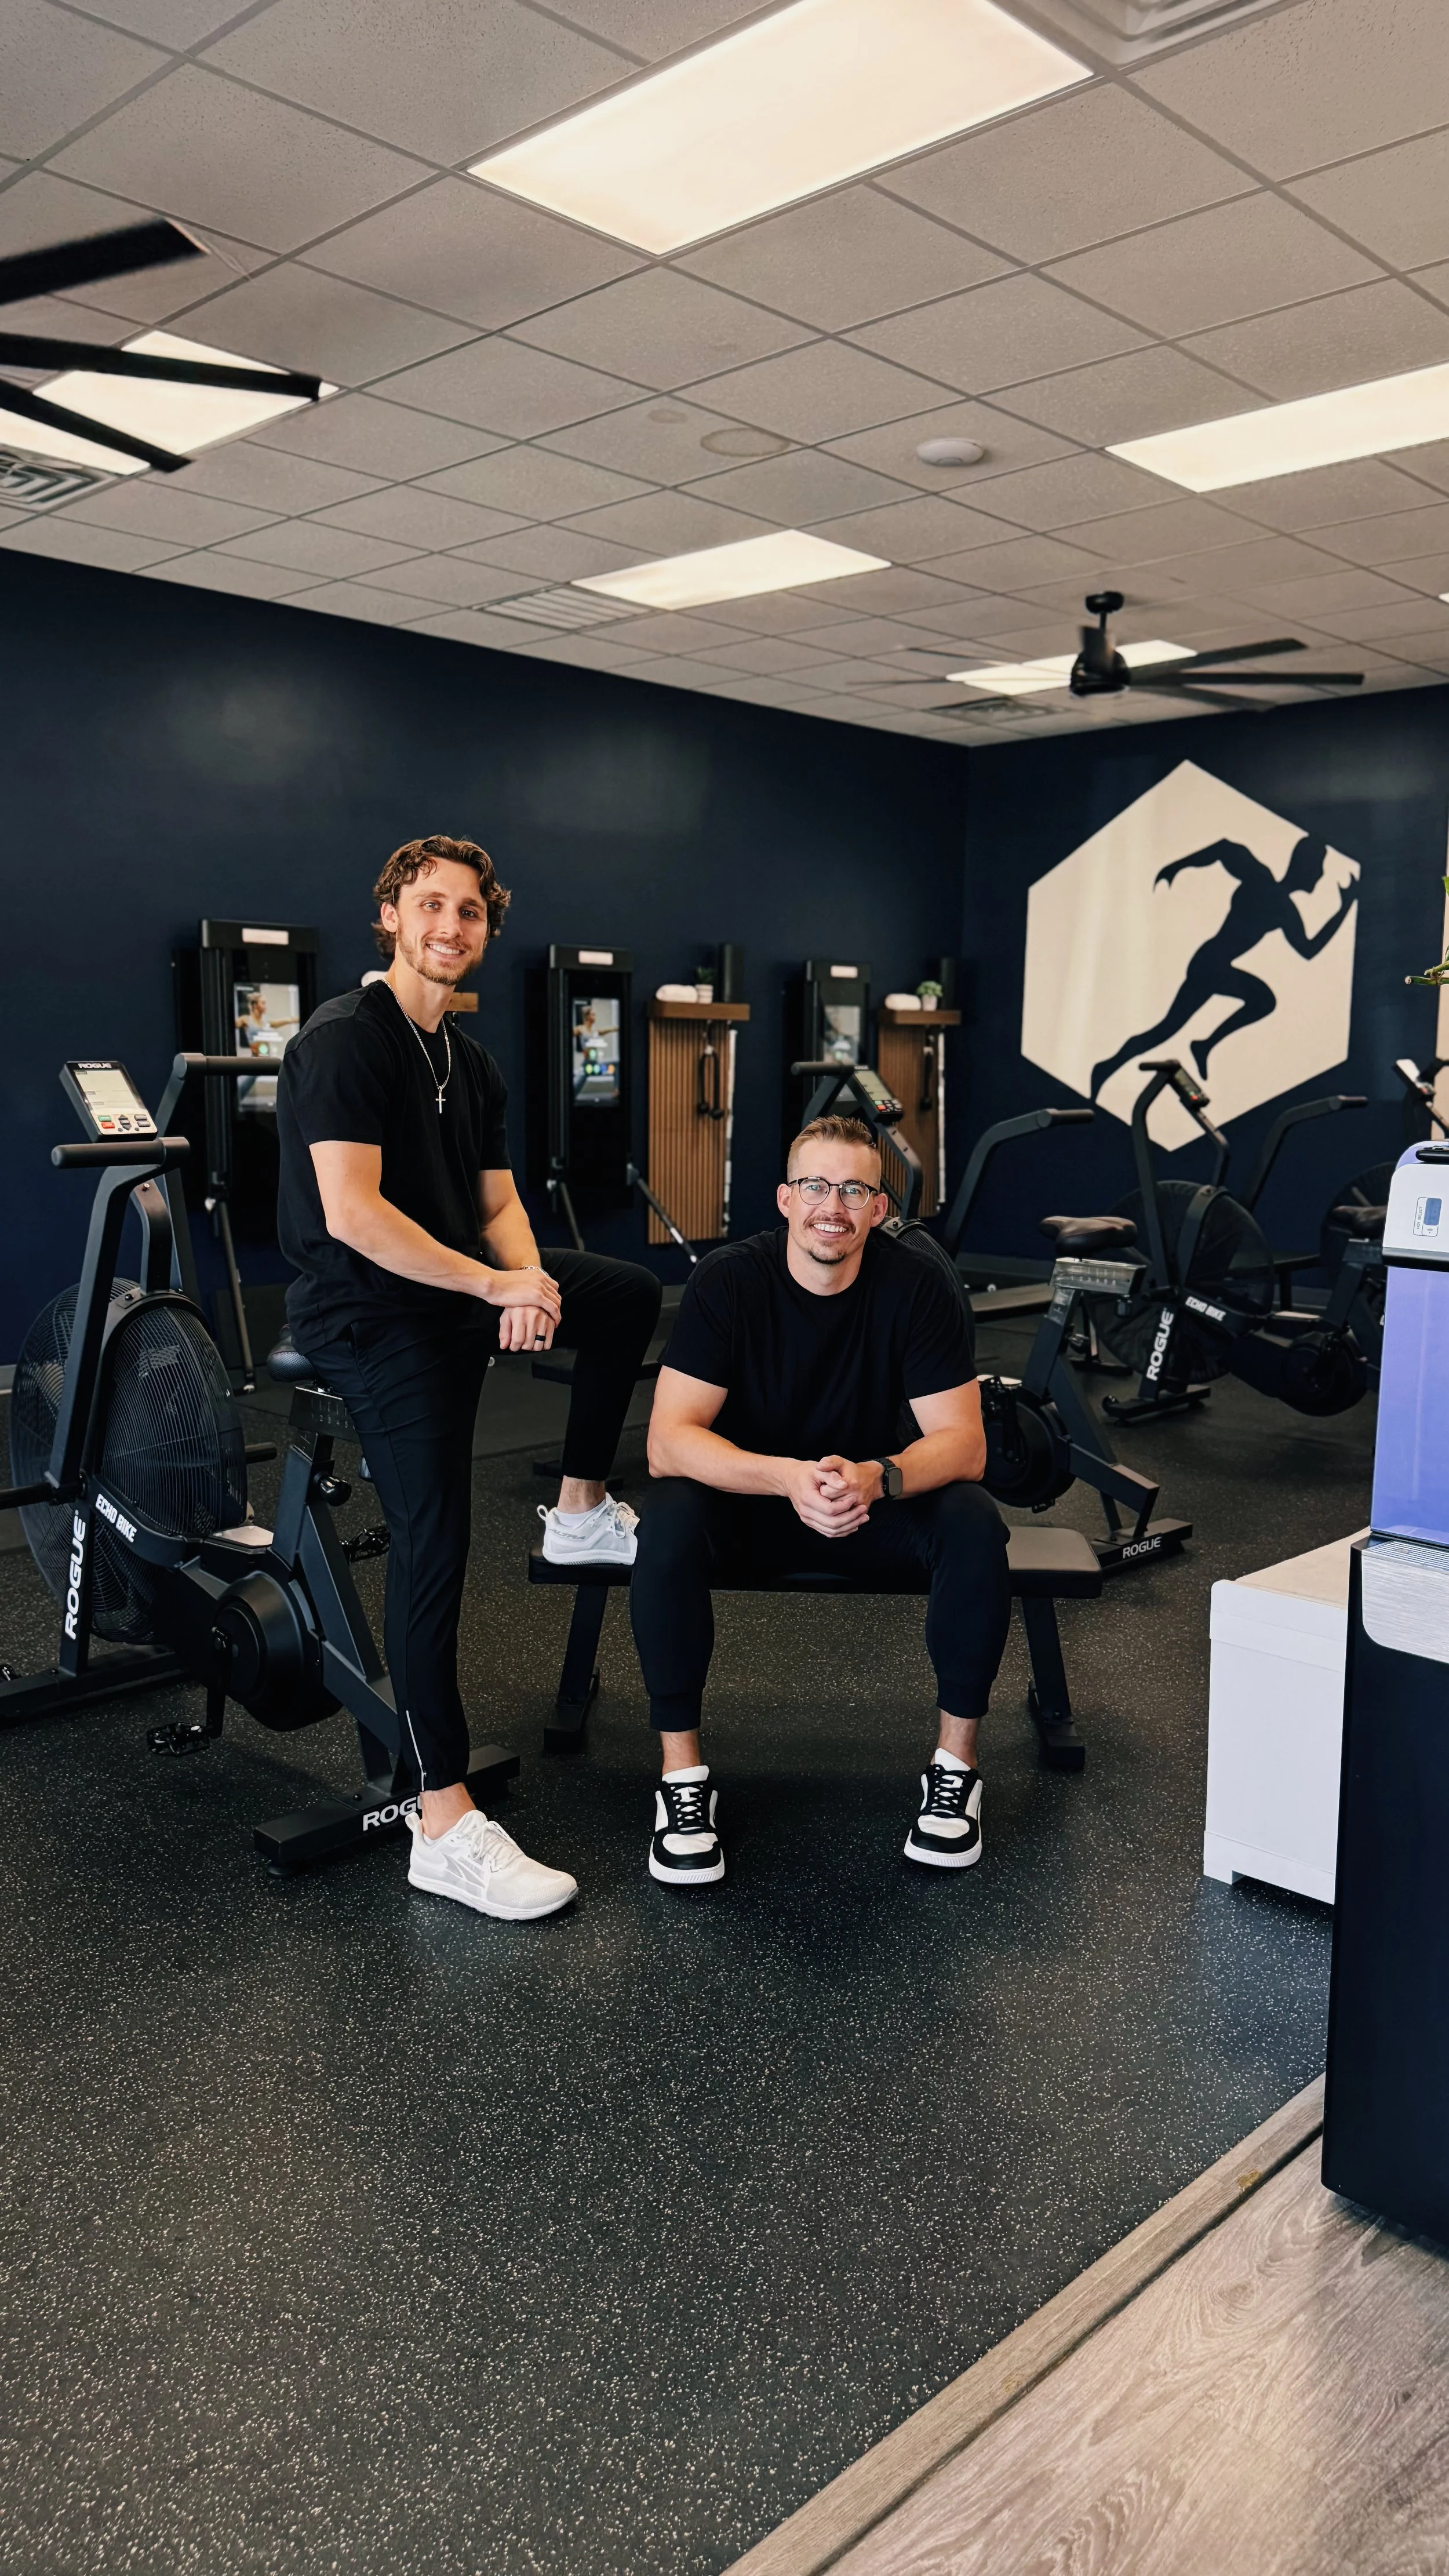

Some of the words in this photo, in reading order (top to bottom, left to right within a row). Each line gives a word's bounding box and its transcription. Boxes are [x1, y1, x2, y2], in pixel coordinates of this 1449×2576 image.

[1185, 1296, 1207, 1313] ECHO
[1205, 1305, 1226, 1322] BIKE
[1146, 1310, 1174, 1381] ROGUE
[96, 1493, 118, 1523] ECHO
[116, 1513, 137, 1542] BIKE
[1123, 1537, 1162, 1559] ROGUE
[64, 1515, 86, 1640] ROGUE
[363, 1796, 423, 1831] ROG
